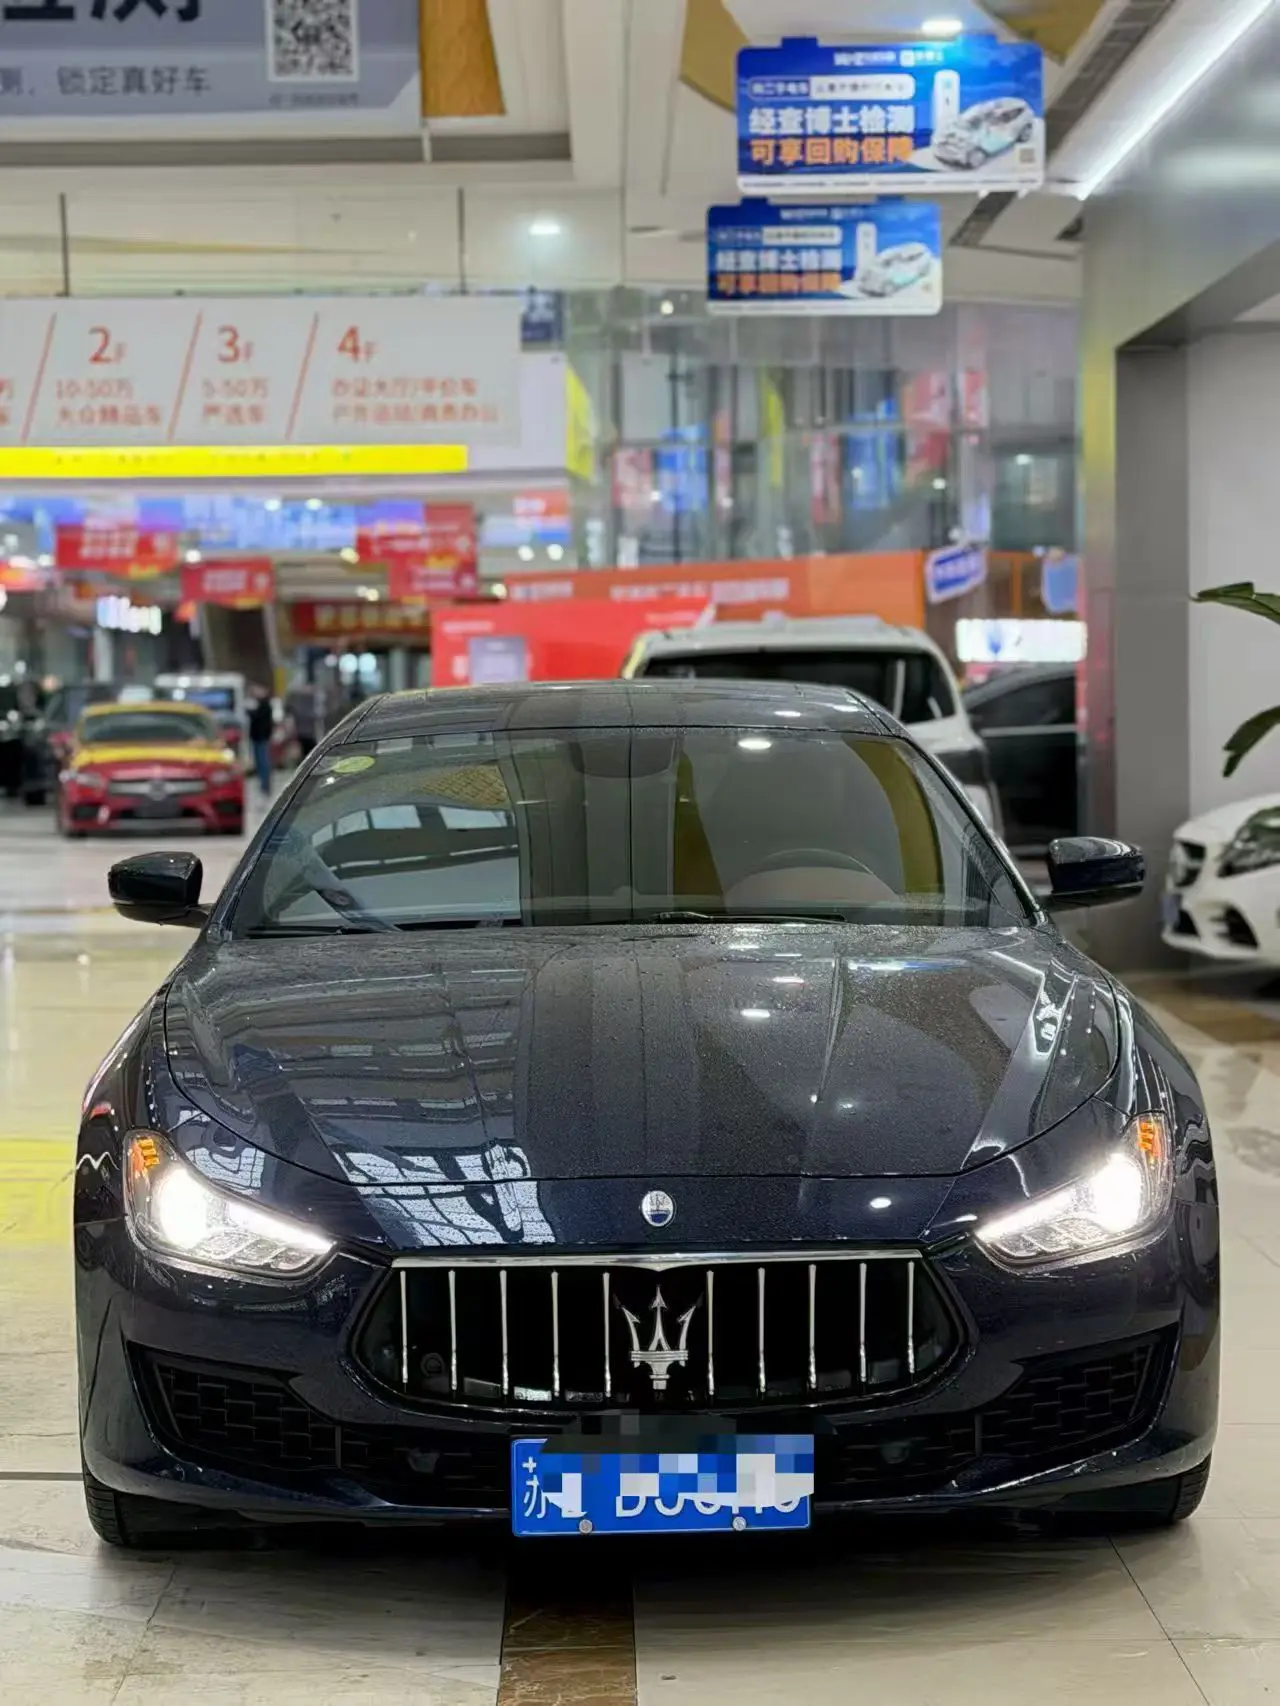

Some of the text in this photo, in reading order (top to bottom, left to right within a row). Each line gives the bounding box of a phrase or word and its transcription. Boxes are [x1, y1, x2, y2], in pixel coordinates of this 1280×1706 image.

[750, 106, 915, 134] 经查博士检测
[751, 137, 913, 165] 可享回购保障
